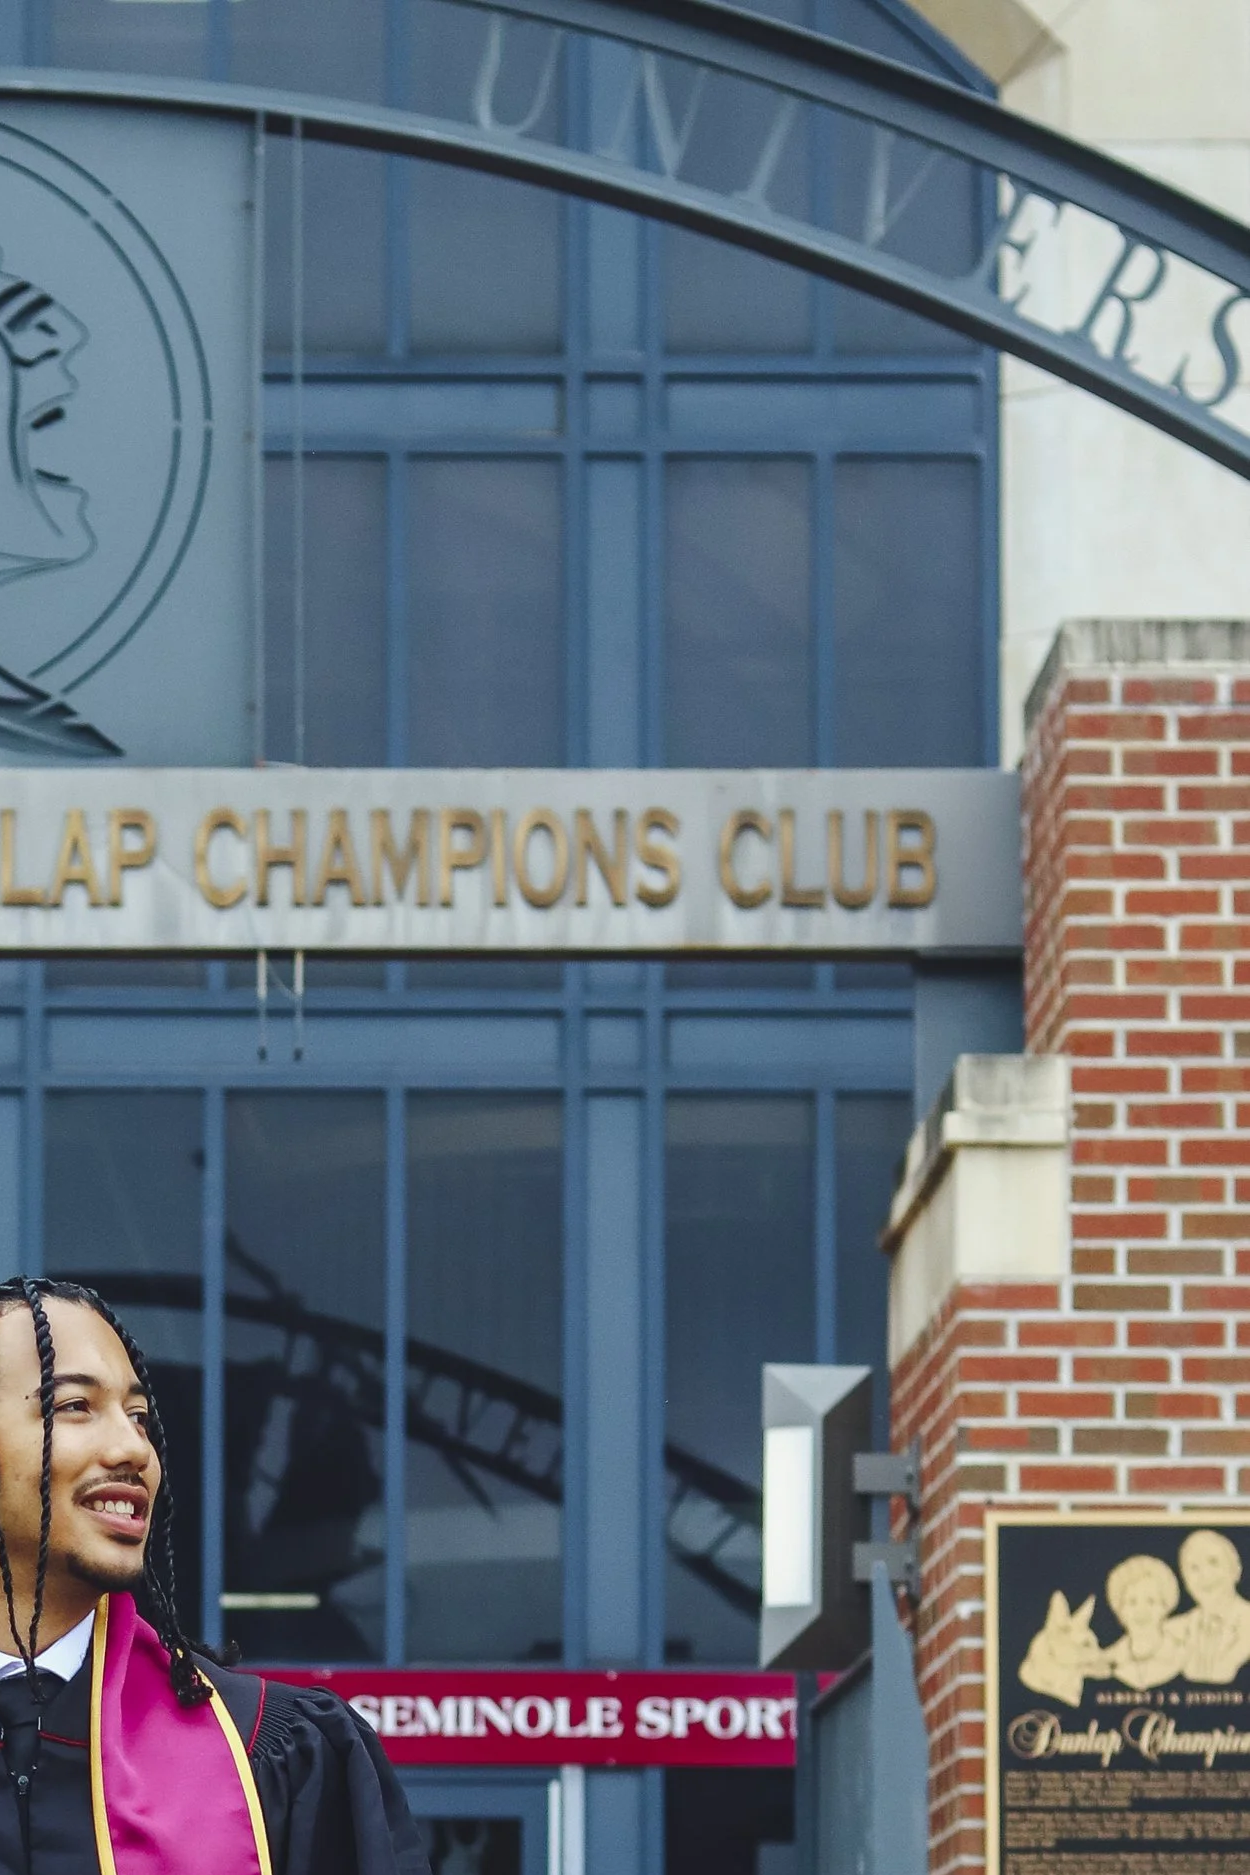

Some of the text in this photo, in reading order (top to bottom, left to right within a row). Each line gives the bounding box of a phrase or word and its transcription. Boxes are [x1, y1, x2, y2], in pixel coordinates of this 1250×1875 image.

[194, 807, 682, 910] CHAMPIONS
[719, 807, 940, 910] CLUB
[348, 1694, 625, 1738] SEMINOLE
